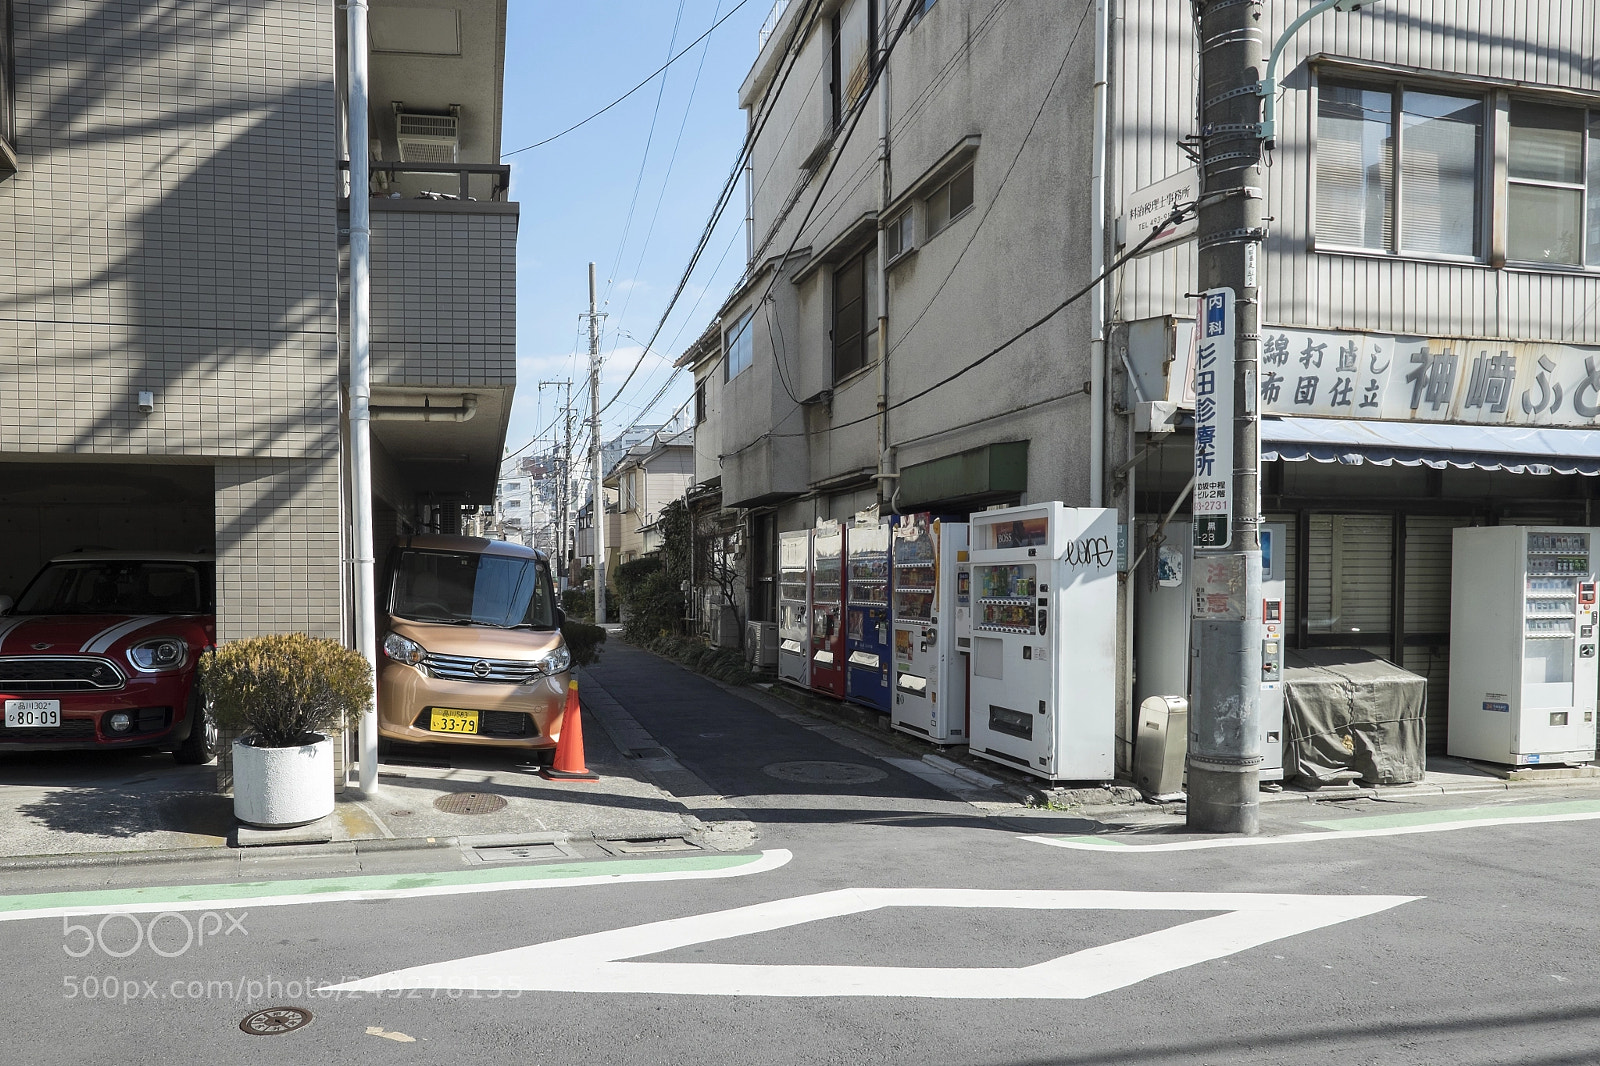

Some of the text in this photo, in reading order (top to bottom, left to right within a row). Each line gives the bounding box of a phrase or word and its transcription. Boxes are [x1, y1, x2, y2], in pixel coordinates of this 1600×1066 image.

[1138, 222, 1148, 231] TEL
[1208, 295, 1223, 335] 内科
[1262, 333, 1391, 375] 綿打直し
[1261, 372, 1380, 409] 布団仕立
[1195, 342, 1217, 477] 杉田診療所
[998, 533, 1012, 543] BOSS
[1207, 562, 1229, 613] 注意
[17, 711, 57, 725] 80-09
[440, 718, 475, 732] 33-79
